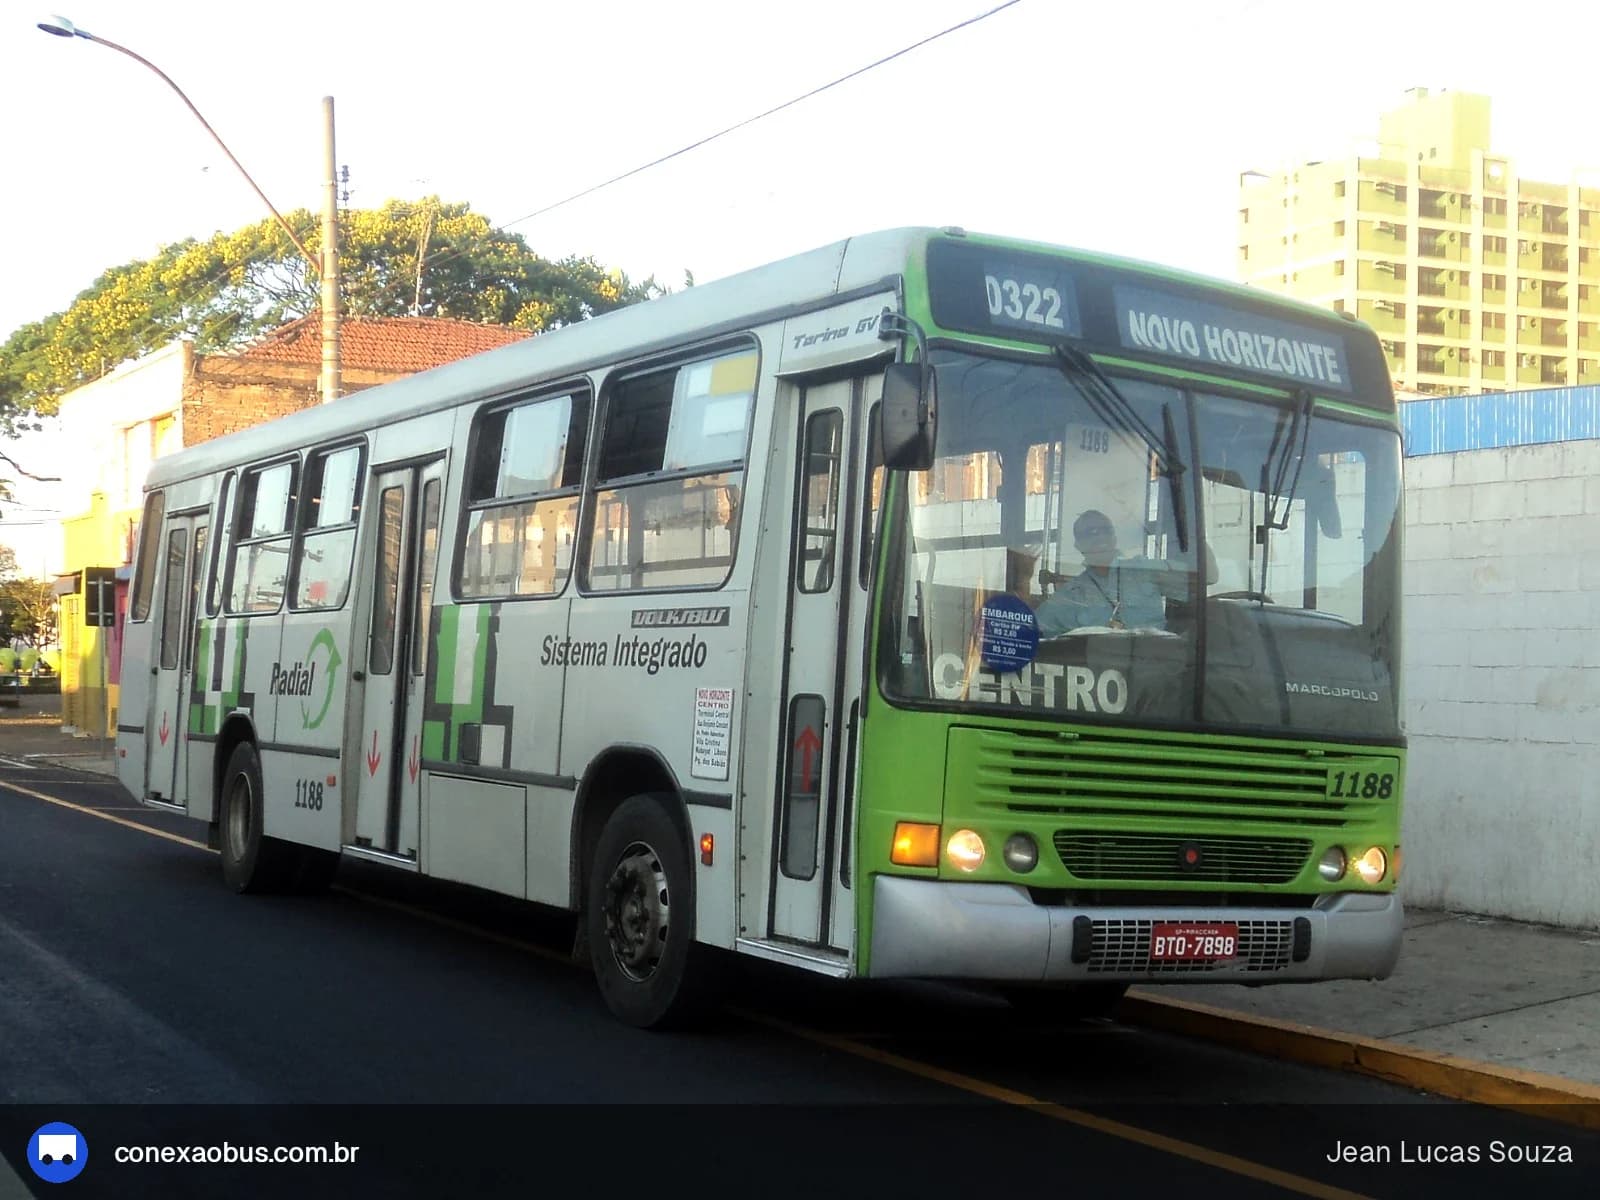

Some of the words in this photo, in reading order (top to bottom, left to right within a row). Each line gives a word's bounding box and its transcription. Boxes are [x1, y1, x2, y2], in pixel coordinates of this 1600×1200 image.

[793, 327, 850, 349] Torino
[855, 315, 879, 334] GV
[1128, 308, 1201, 358] NOVO
[1203, 324, 1342, 384] HORIZONTE
[981, 607, 1034, 623] EMBARQUE
[540, 634, 609, 667] Sistema
[613, 633, 708, 675] Integrado
[269, 661, 316, 697] Radial
[932, 652, 1128, 715] CENTRO
[1286, 682, 1379, 702] MARCOPOLO
[698, 701, 729, 709] CENTRO
[294, 778, 323, 812] 1188
[1330, 771, 1394, 799] 1188
[1154, 936, 1235, 956] BTO-7898
